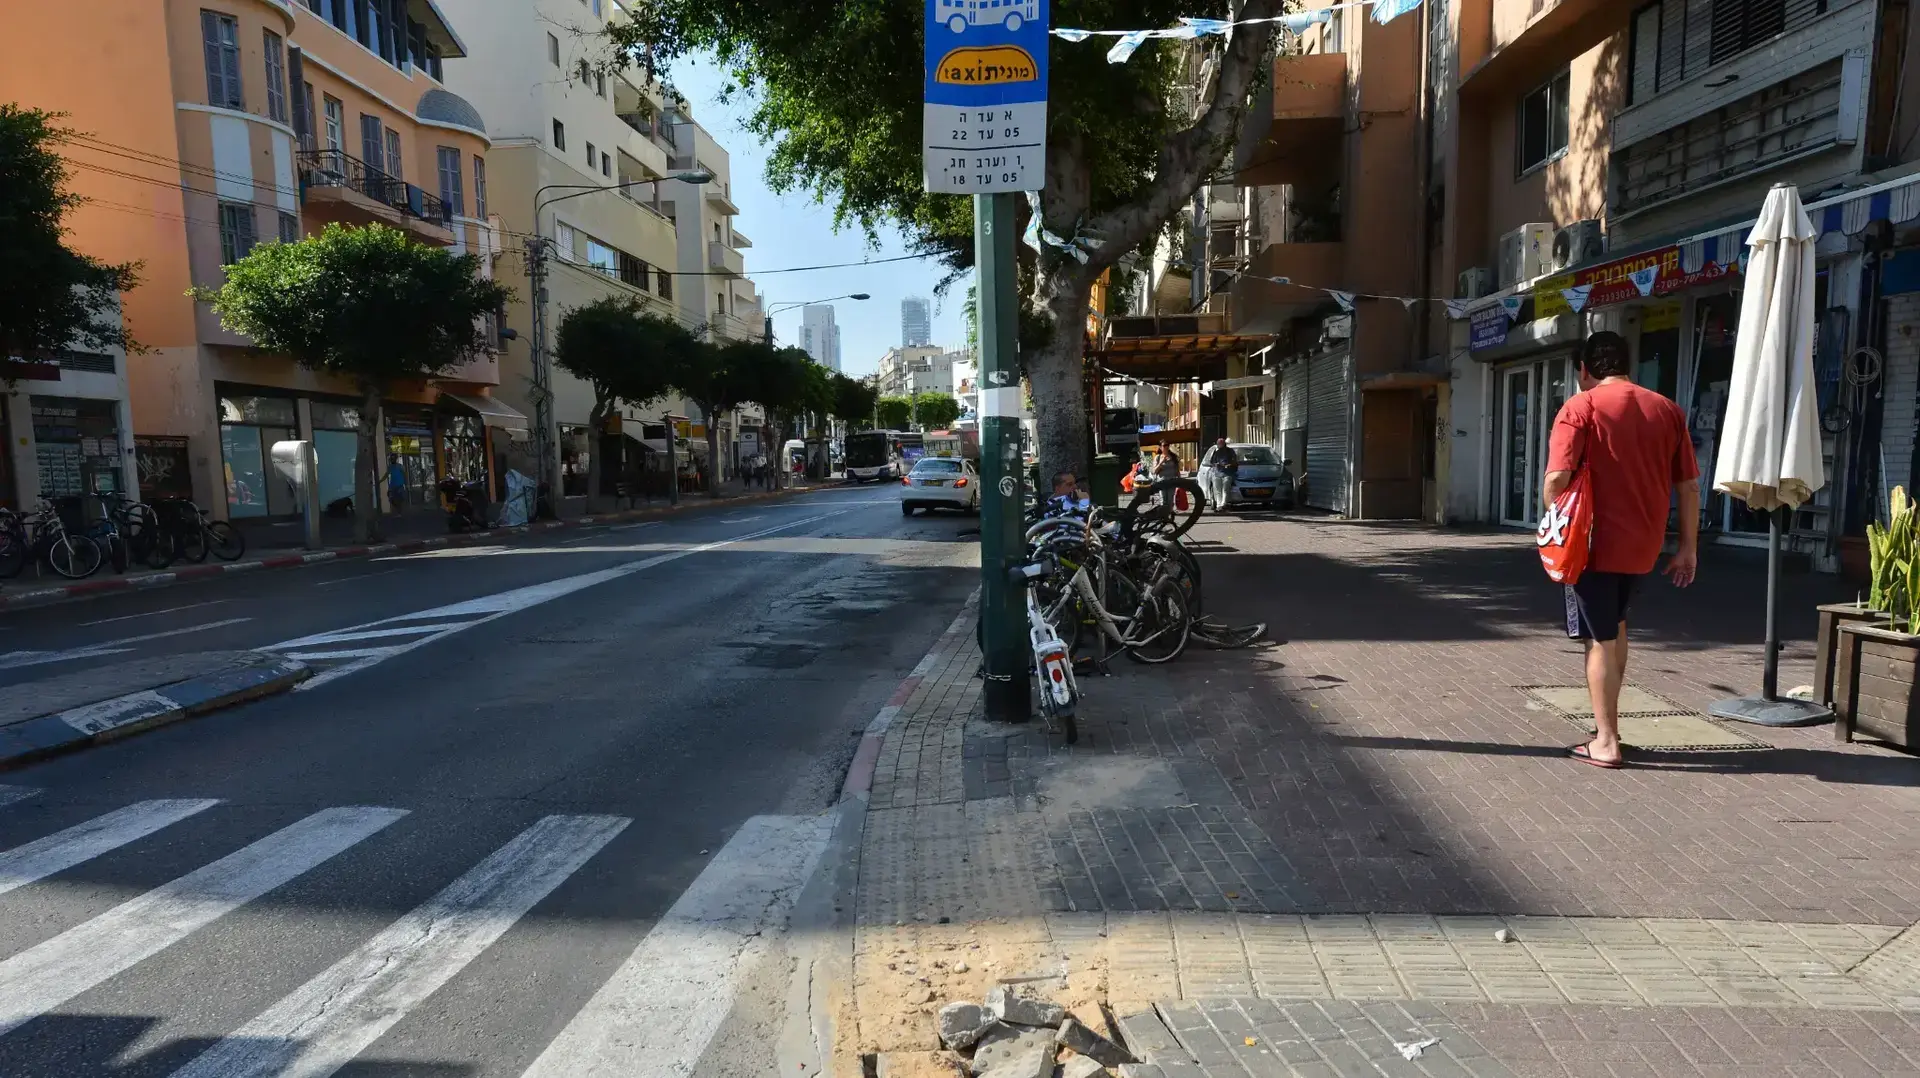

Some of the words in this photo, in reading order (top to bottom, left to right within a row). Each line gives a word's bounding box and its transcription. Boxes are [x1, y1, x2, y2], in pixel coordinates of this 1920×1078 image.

[944, 59, 983, 80] taxi
[984, 66, 1030, 81] מונית
[959, 113, 967, 123] ה
[977, 112, 994, 123] עד
[1004, 110, 1013, 121] א
[952, 130, 967, 140] 22
[978, 129, 994, 140] עד
[1004, 127, 1020, 138] 05
[976, 157, 1006, 168] וערב
[953, 174, 966, 185] 18
[976, 174, 992, 185] עד
[1002, 173, 1018, 183] 05
[984, 221, 992, 235] 3
